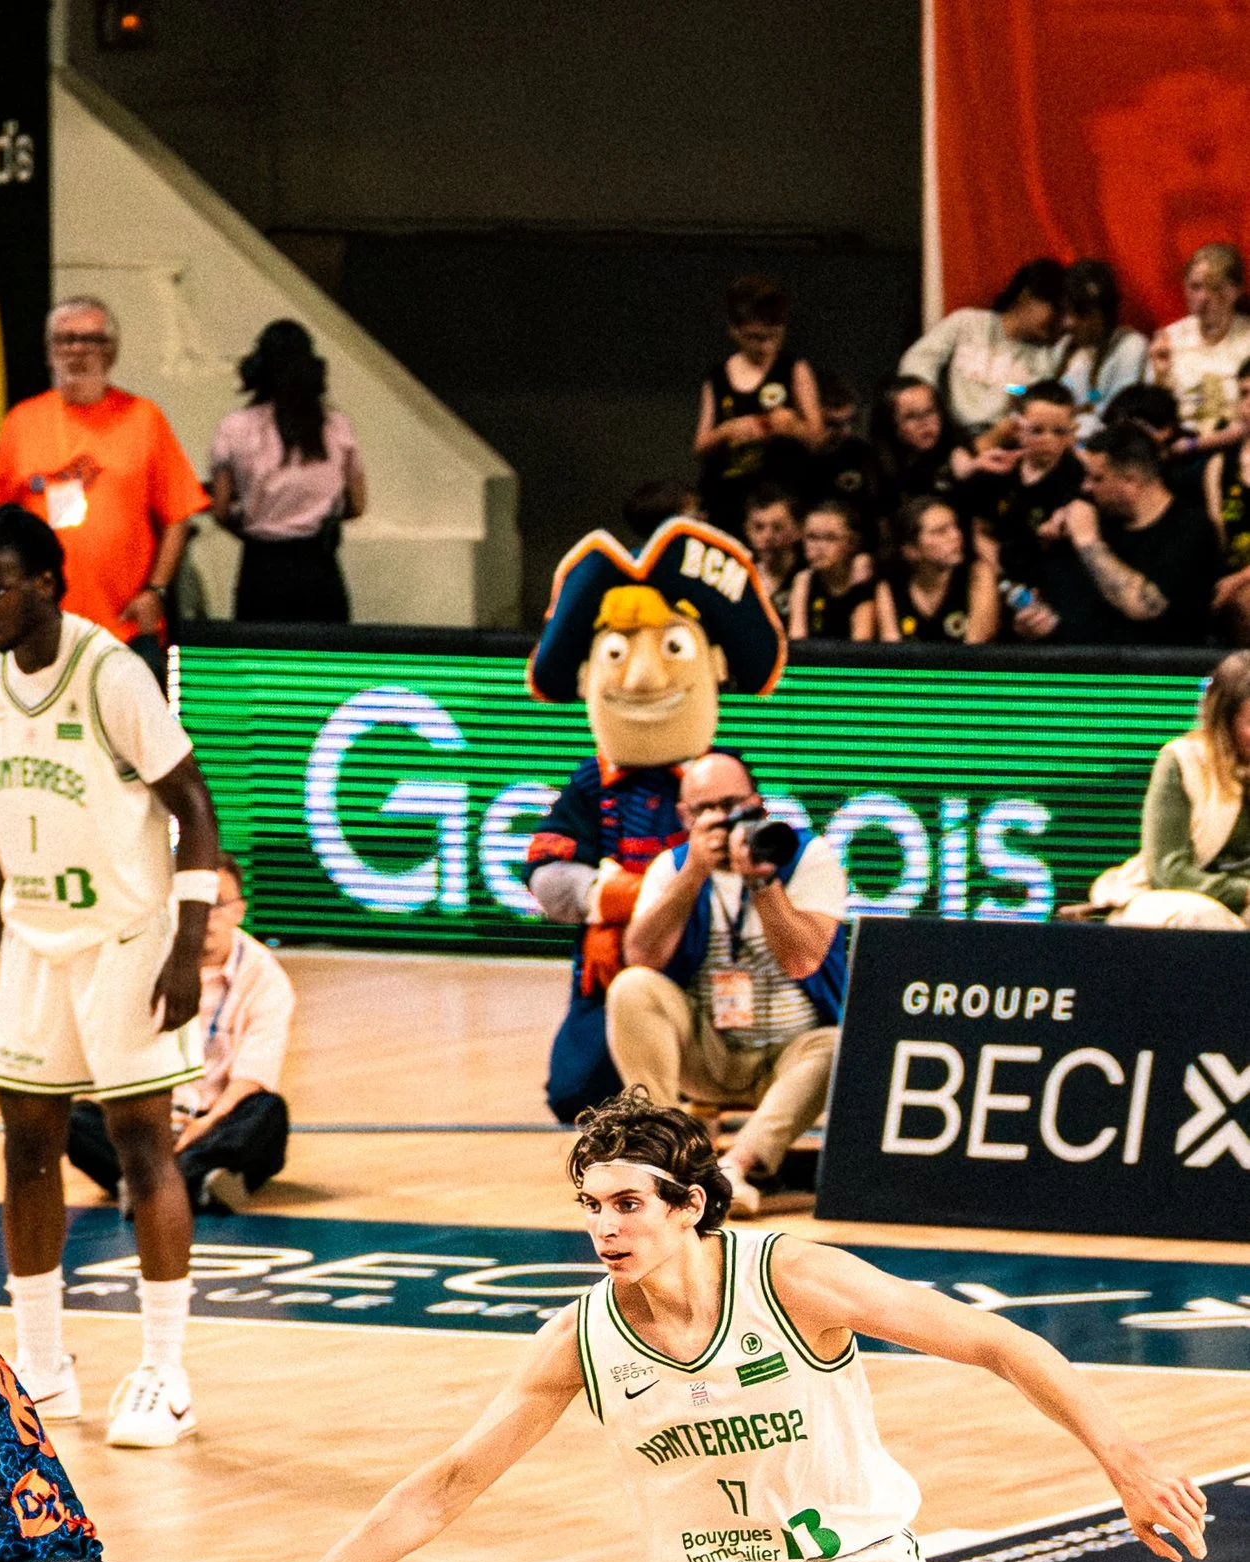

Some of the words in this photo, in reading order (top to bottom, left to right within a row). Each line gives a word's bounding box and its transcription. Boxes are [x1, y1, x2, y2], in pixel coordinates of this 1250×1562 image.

[680, 537, 749, 604] BCM
[29, 814, 38, 854] 1
[902, 978, 1077, 1021] GROUPE
[610, 1362, 639, 1375] IDEC
[635, 1409, 808, 1466] NANTERRE92
[716, 1478, 749, 1517] 17
[681, 1529, 773, 1550] Bouygues
